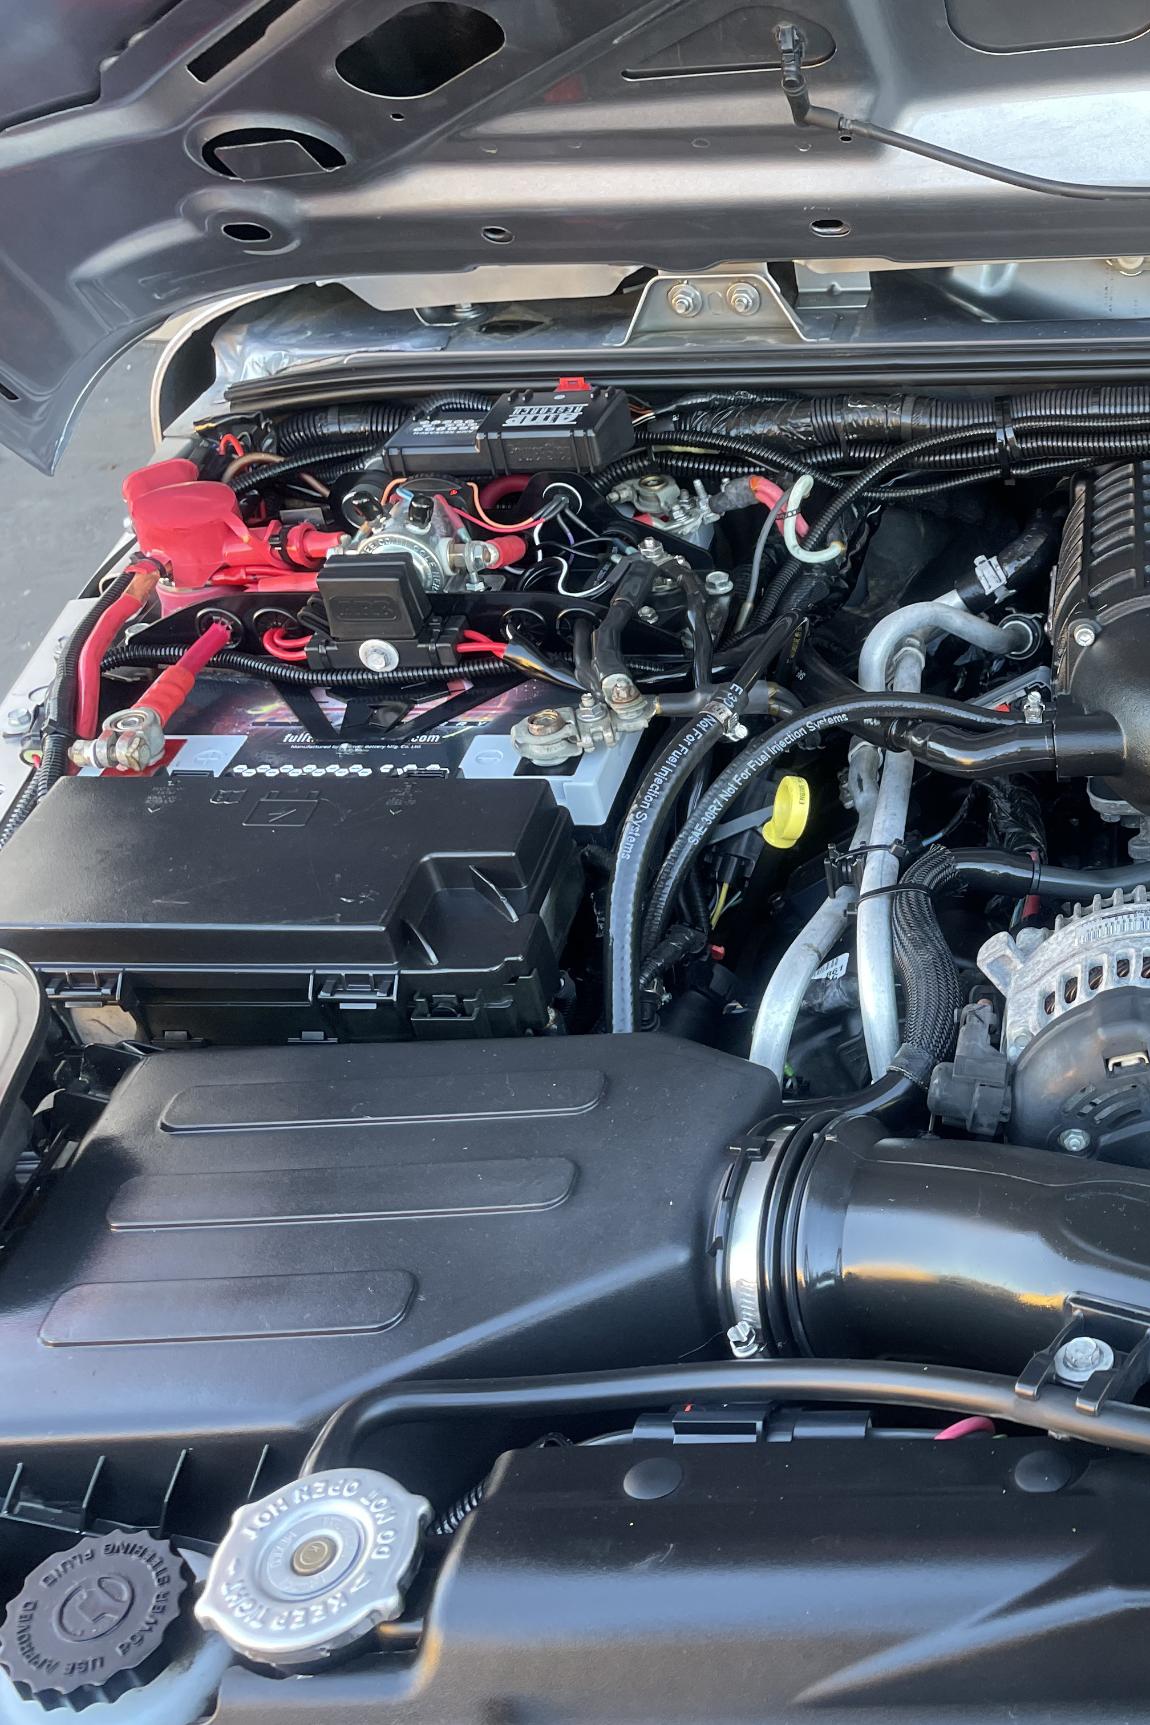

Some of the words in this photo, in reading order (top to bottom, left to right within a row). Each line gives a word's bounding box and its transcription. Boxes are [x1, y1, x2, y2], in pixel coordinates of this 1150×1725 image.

[683, 727, 701, 745] For
[699, 715, 718, 733] Not
[665, 743, 689, 767] Fuel
[640, 762, 673, 809] Injection
[687, 823, 708, 846] SAE
[701, 796, 724, 824] 30R7
[719, 783, 738, 802] Not
[735, 767, 752, 786] For
[747, 750, 770, 773] Fuel
[768, 727, 807, 755] Injection
[806, 713, 849, 733] Systems
[621, 811, 648, 860] Systems
[294, 1478, 361, 1504] OPEN
[360, 1489, 397, 1525] NOT
[241, 1498, 289, 1541] HOT
[103, 1542, 172, 1587] STEERING
[371, 1529, 396, 1560] DO
[39, 1549, 95, 1588] FLUID
[116, 1590, 171, 1656] POWER
[220, 1581, 270, 1630] TIGHT
[270, 1591, 348, 1631] KEEP
[16, 1599, 61, 1674] APPROVED
[64, 1656, 105, 1676] USE
